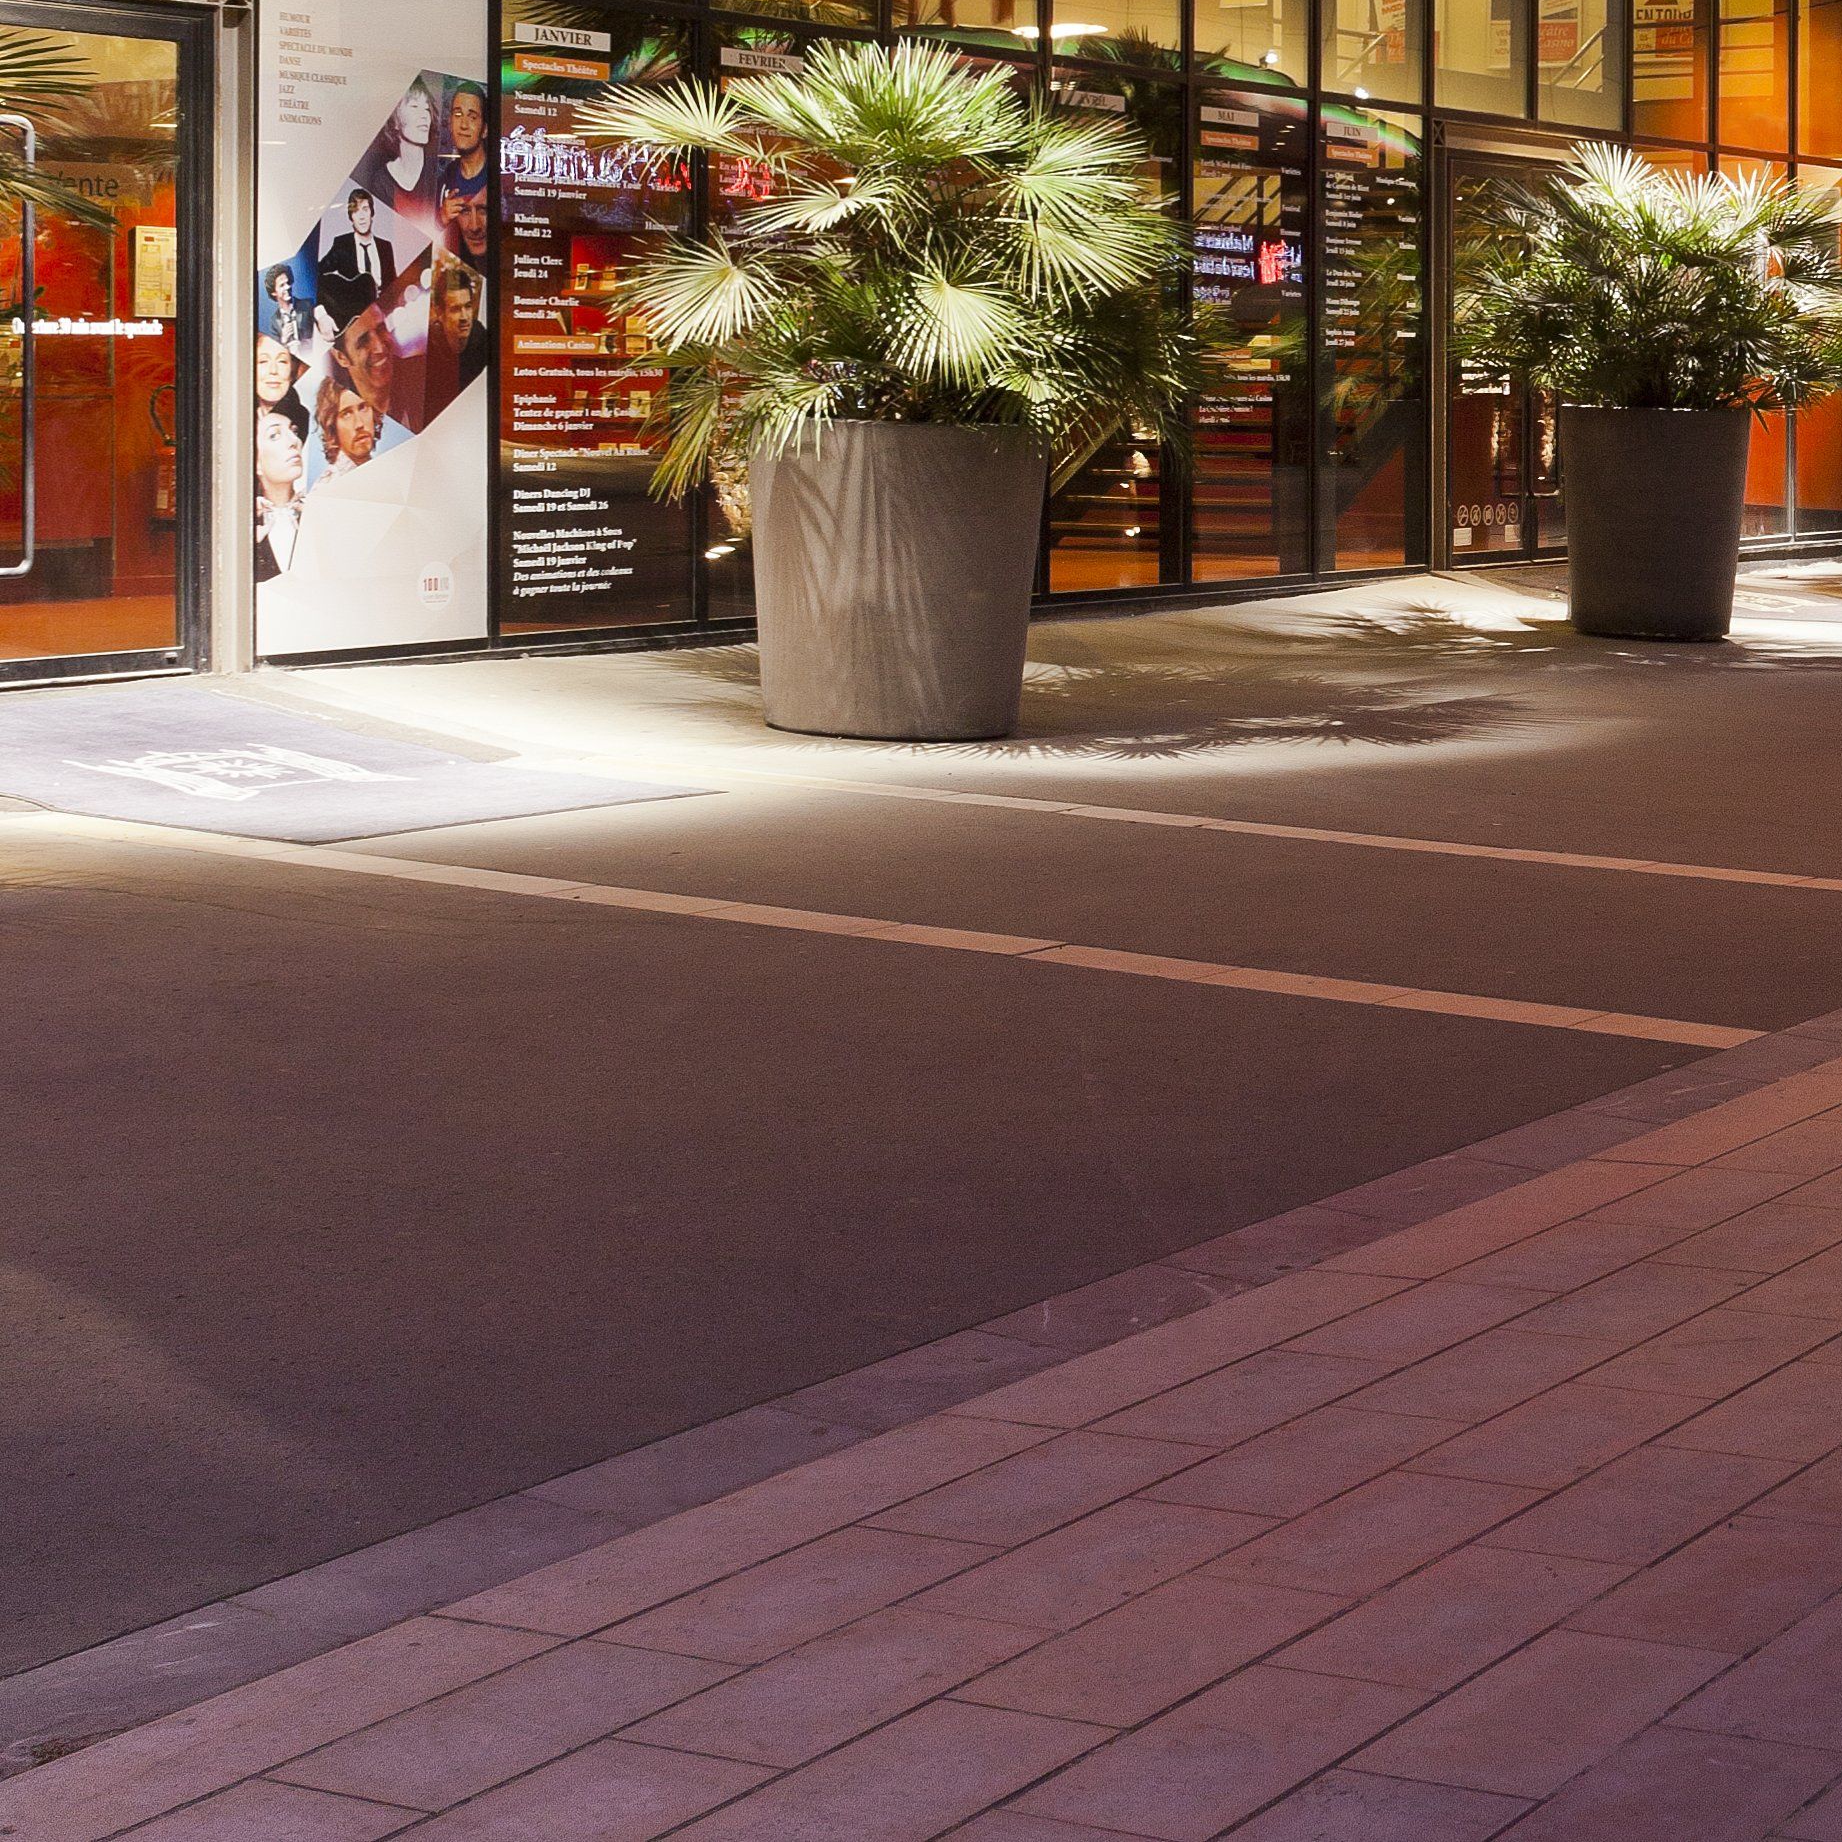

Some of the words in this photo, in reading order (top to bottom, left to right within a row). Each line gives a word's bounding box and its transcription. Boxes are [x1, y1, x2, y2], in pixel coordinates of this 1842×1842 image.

[534, 28, 592, 46] JANVIER
[522, 59, 566, 73] Spectacles
[567, 63, 598, 76] Théâtre
[515, 104, 546, 116] Samedi
[547, 107, 557, 116] 12
[1343, 126, 1361, 136] JUIN
[515, 186, 546, 197] Samedi
[547, 189, 557, 198] 19
[558, 190, 587, 200] janvier
[514, 214, 549, 224] Kheiron
[514, 227, 540, 237] Mardi
[541, 229, 551, 238] 22
[514, 254, 540, 265] Julien
[541, 256, 563, 266] Clerc
[514, 269, 537, 279] Jeudi
[538, 270, 548, 279] 24
[514, 309, 545, 319] Samedi
[568, 341, 595, 350] Casino
[514, 367, 537, 377] Lotos
[513, 422, 557, 431] Dimanche
[565, 421, 594, 432] janvier
[513, 462, 545, 472] Samedi
[579, 488, 591, 498] DJ
[513, 503, 545, 513] Samedi
[546, 503, 557, 512] 19
[567, 501, 597, 511] Samedi
[598, 500, 609, 510] 26
[586, 541, 606, 552] King
[513, 557, 545, 567] Samedi
[546, 557, 557, 566] 19
[557, 555, 587, 567] janvier
[513, 572, 529, 581] Des
[530, 570, 576, 580] animations
[586, 568, 600, 577] des
